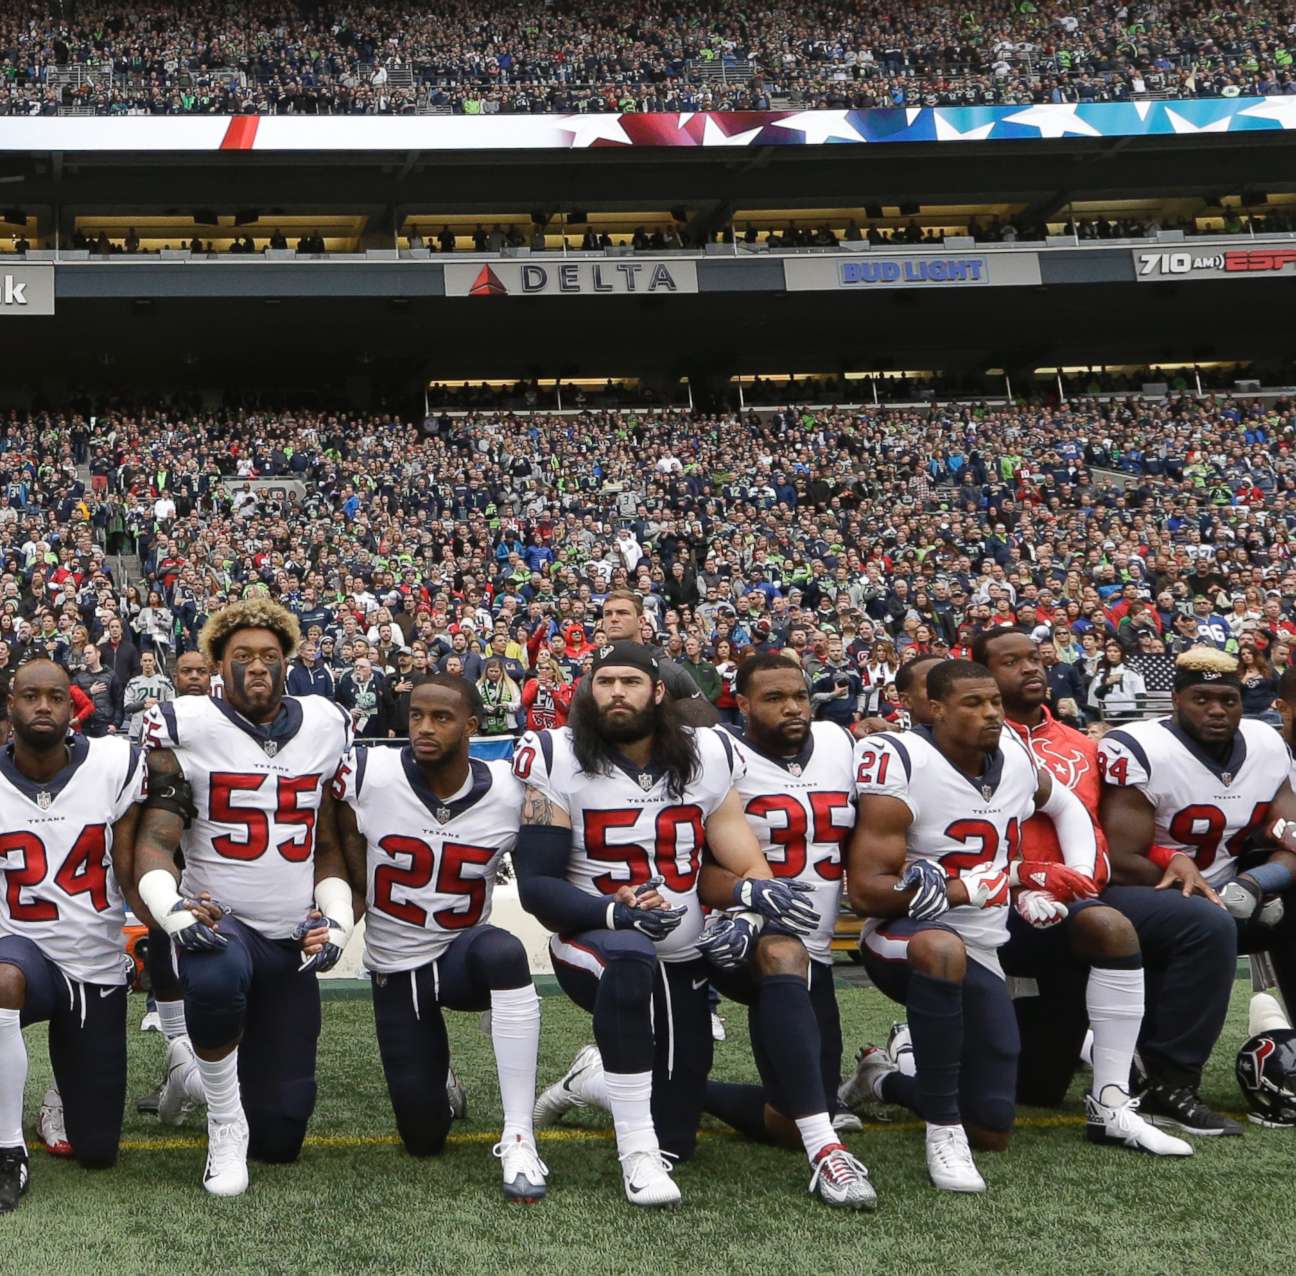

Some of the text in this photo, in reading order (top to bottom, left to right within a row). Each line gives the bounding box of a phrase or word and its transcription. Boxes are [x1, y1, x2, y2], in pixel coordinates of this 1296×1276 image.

[520, 263, 678, 293] DELTA
[843, 259, 983, 284] BUD LIGHT
[1140, 253, 1191, 275] 710
[1193, 257, 1214, 269] AM
[254, 763, 289, 771] TEXANS
[856, 751, 891, 785] 21
[27, 816, 65, 824] TEXANS
[209, 772, 322, 862] 55
[422, 829, 460, 838] TEXANS
[582, 804, 704, 893] 50
[744, 791, 850, 881] 35
[373, 834, 498, 930] 25
